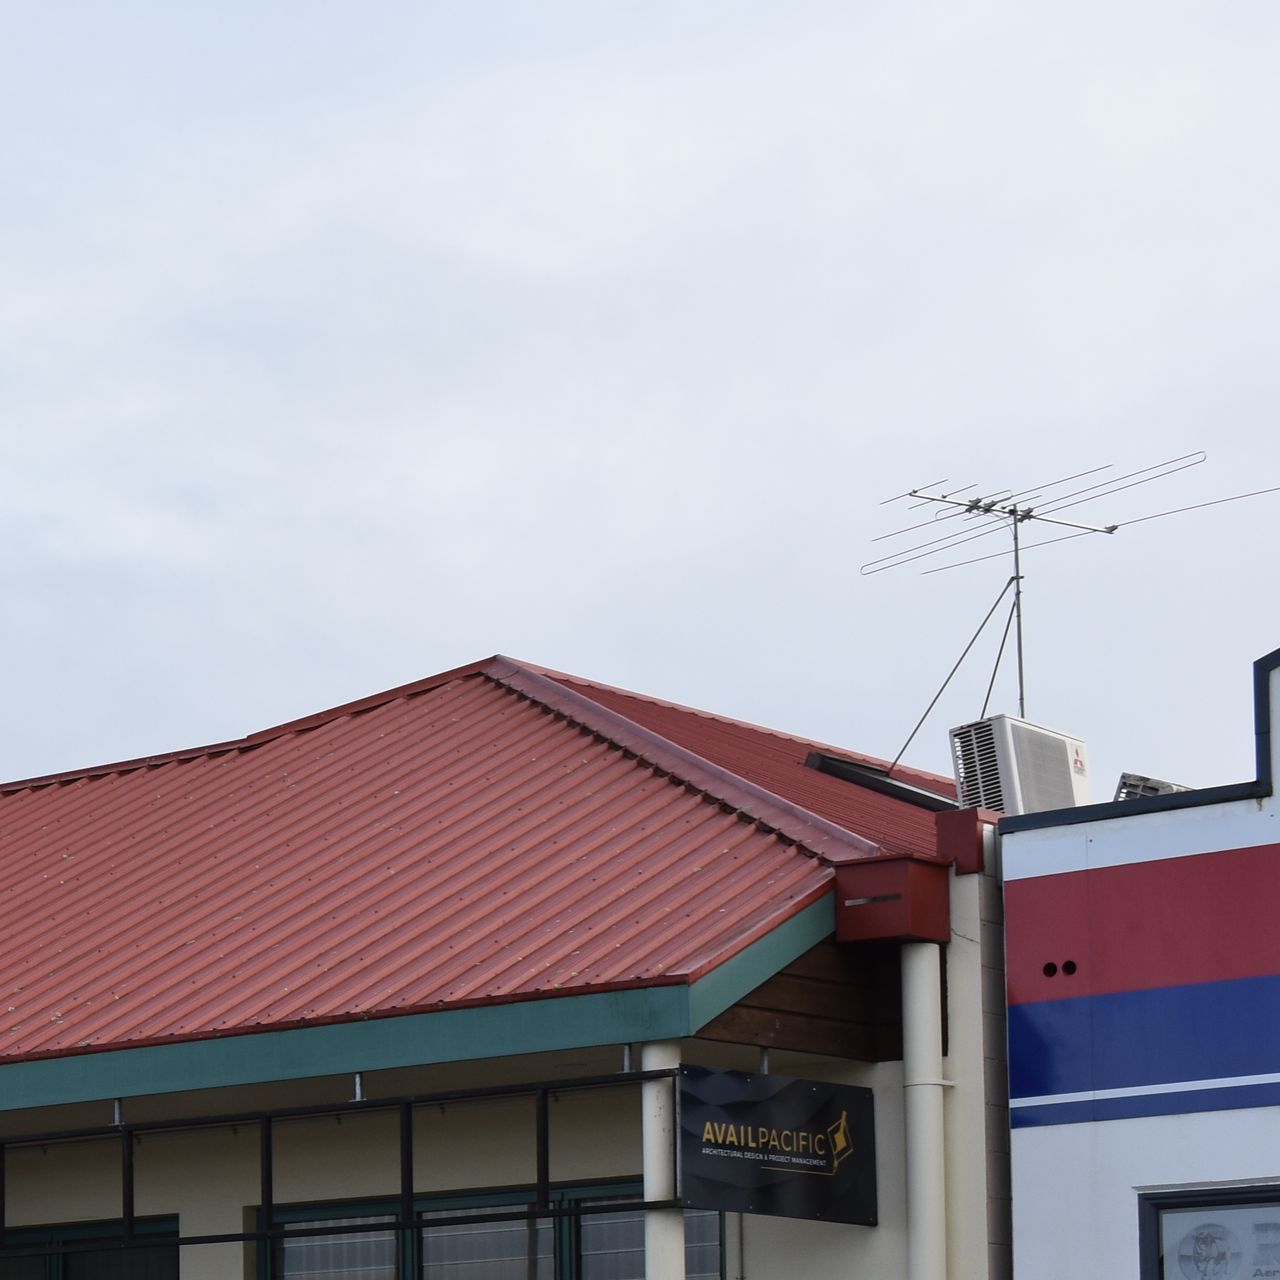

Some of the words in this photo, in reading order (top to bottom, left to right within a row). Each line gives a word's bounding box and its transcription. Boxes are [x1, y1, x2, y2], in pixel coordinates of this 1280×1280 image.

[702, 1121, 825, 1155] AVAILPACIFIC
[702, 1148, 743, 1158] ARCHITECTURAL
[744, 1152, 763, 1160] DESIGN
[769, 1154, 791, 1163] PROJECT
[792, 1157, 827, 1166] MANAGEMENT
